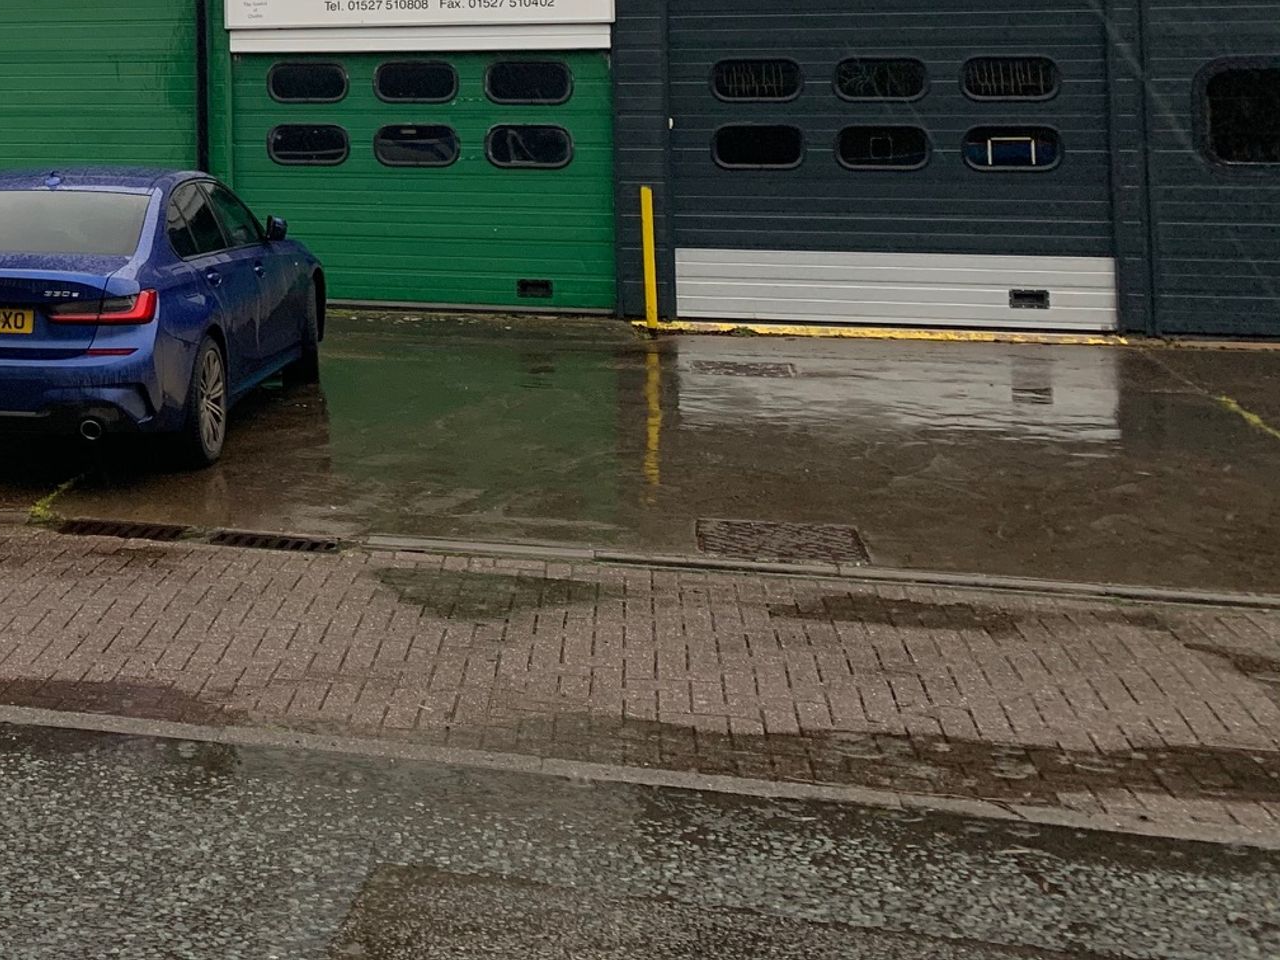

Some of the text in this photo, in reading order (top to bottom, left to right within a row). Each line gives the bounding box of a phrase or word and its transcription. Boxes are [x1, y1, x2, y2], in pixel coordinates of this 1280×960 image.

[324, 1, 345, 11] Tel.
[347, 0, 383, 11] 01527
[385, 0, 429, 10] 510808
